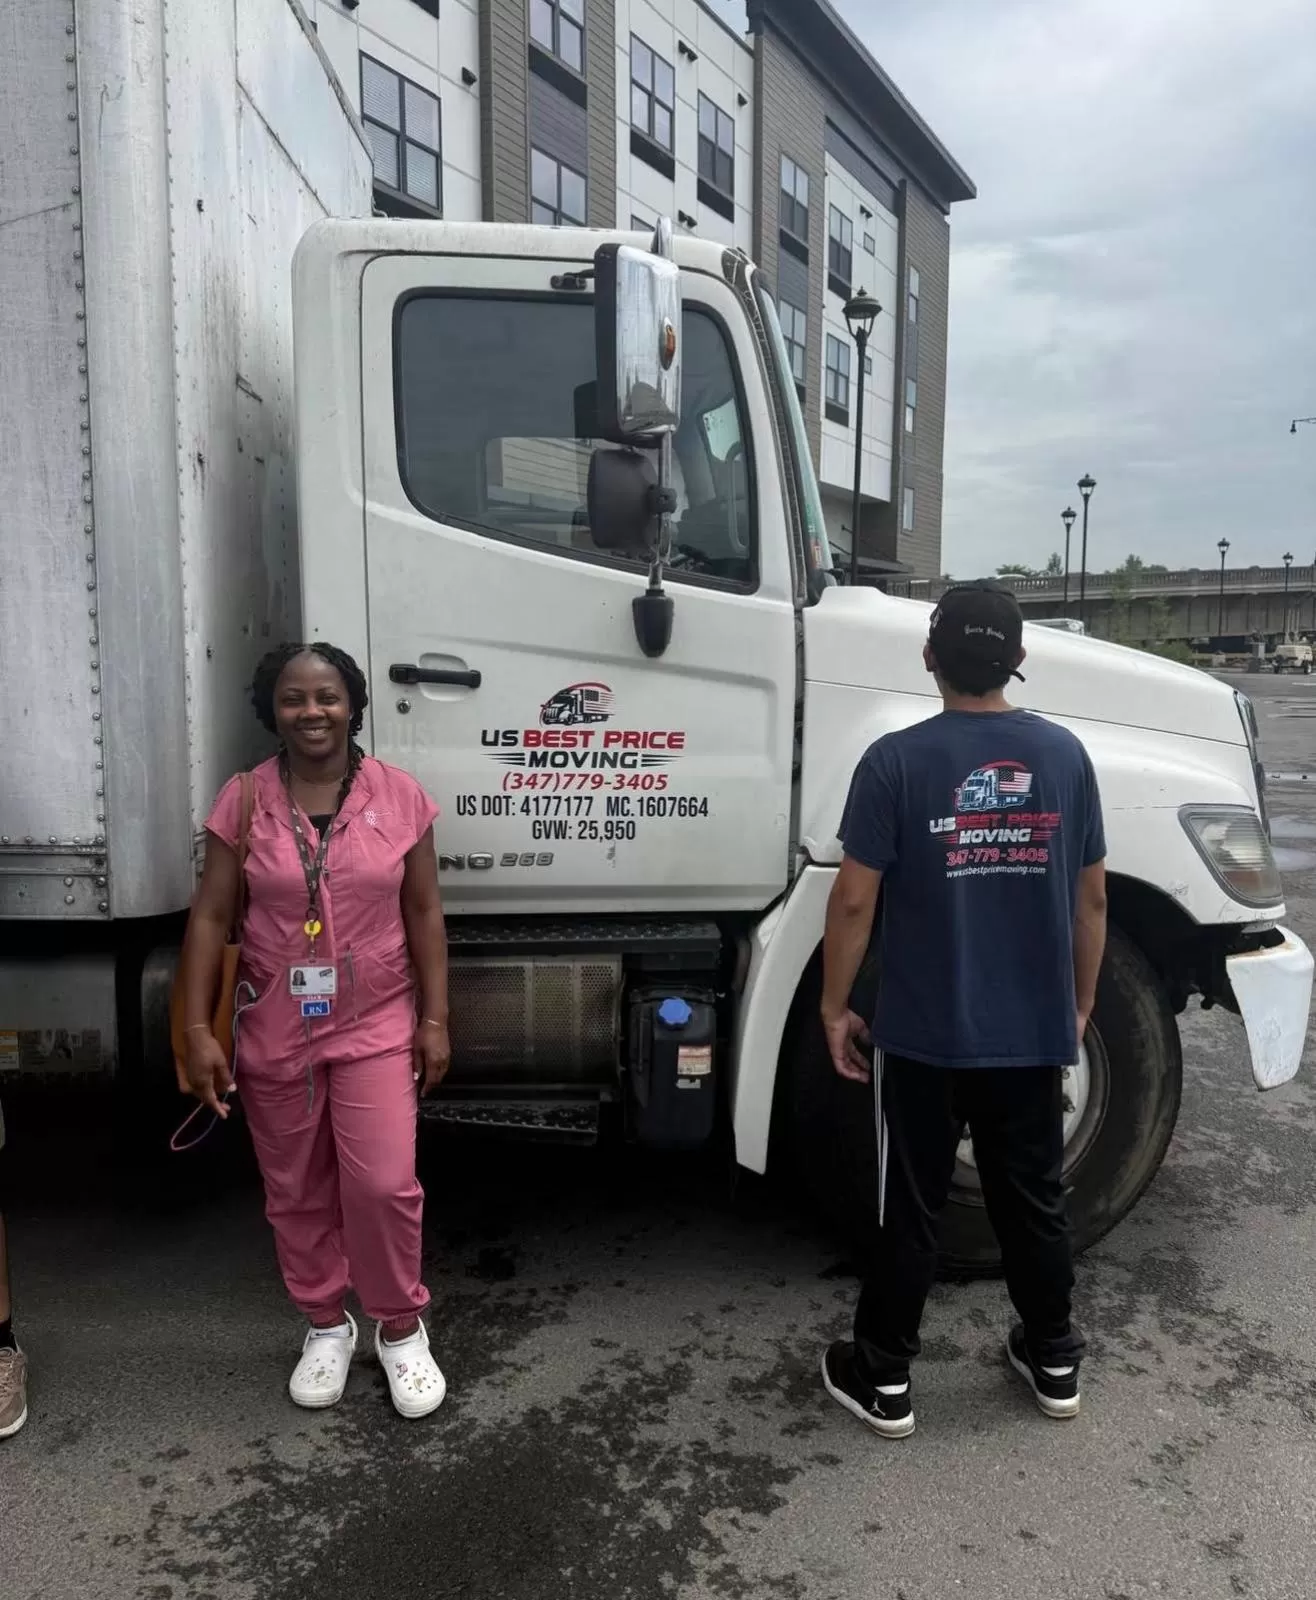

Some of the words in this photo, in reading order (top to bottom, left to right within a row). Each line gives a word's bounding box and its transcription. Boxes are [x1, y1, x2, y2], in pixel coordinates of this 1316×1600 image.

[481, 730, 518, 748] US
[523, 730, 594, 748] BEST
[603, 731, 685, 749] PRICE
[528, 752, 638, 768] MOVING
[502, 773, 668, 791] (347)779-3405
[457, 796, 477, 815] US
[482, 796, 516, 815] DOT:
[520, 797, 593, 815] 4177177
[606, 797, 709, 817] MC.1607664
[1006, 812, 1061, 828] PRICE
[532, 820, 573, 839] GVW:
[577, 821, 636, 842] 25,950
[959, 828, 1032, 844] MOVING
[499, 852, 554, 866] 268
[946, 848, 1049, 866] 347-779-3405
